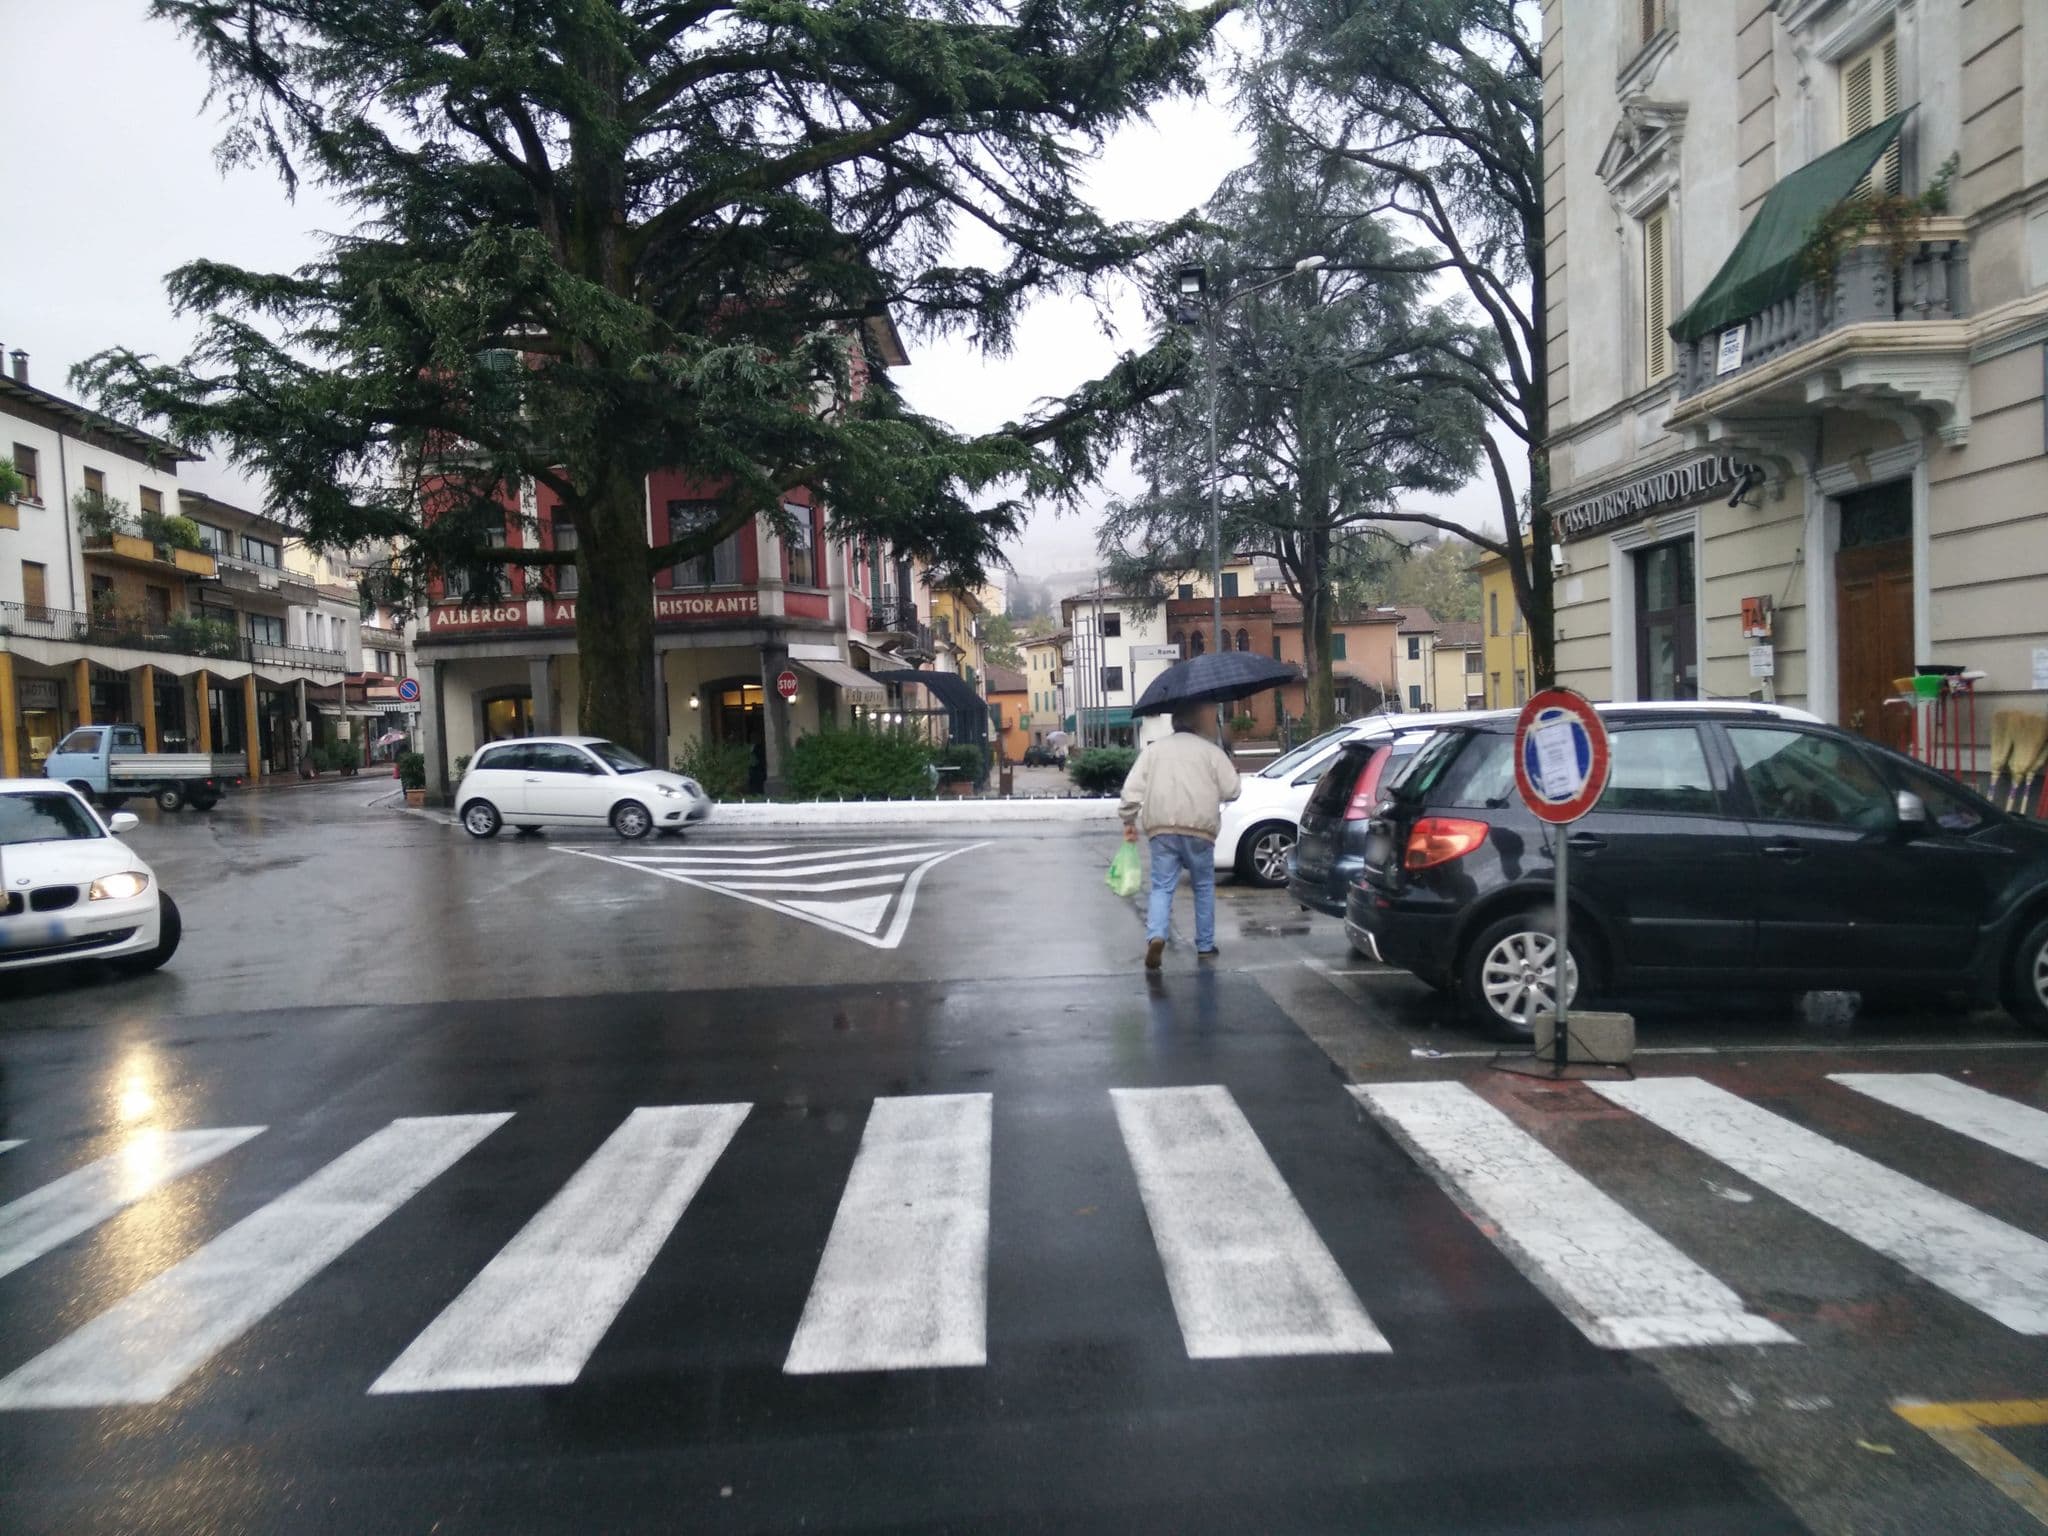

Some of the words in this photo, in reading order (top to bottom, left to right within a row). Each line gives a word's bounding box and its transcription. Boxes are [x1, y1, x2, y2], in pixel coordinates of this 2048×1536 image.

[1556, 502, 1593, 537] CASSA
[1592, 497, 1607, 523] DI
[1605, 471, 1678, 520] RISPARMIO
[1679, 463, 1700, 495] DI
[659, 597, 758, 616] RISTORANTE
[436, 607, 521, 625] ALBERGO
[778, 680, 797, 690] STOP
